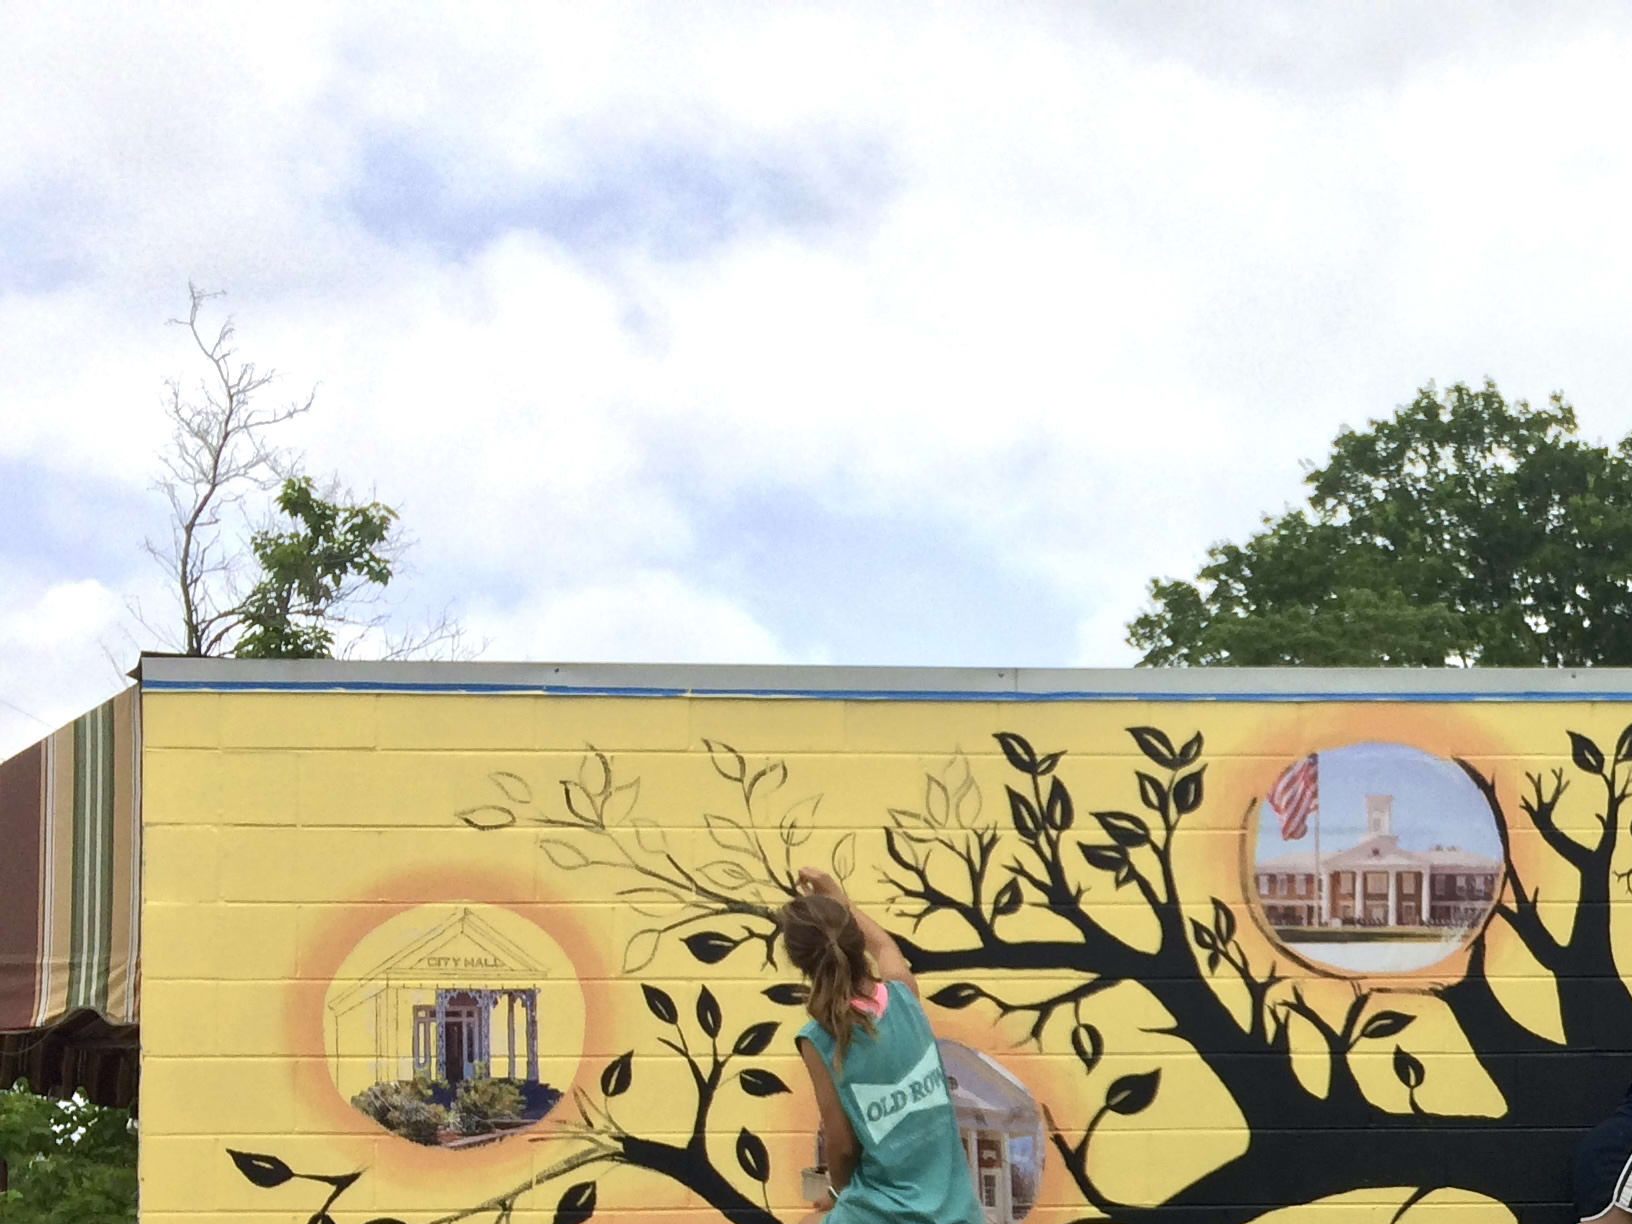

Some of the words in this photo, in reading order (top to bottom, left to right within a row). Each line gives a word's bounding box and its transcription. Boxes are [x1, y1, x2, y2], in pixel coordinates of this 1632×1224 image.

[427, 956, 460, 968] CITY
[464, 956, 504, 969] HALL
[867, 1089, 908, 1122] OLD
